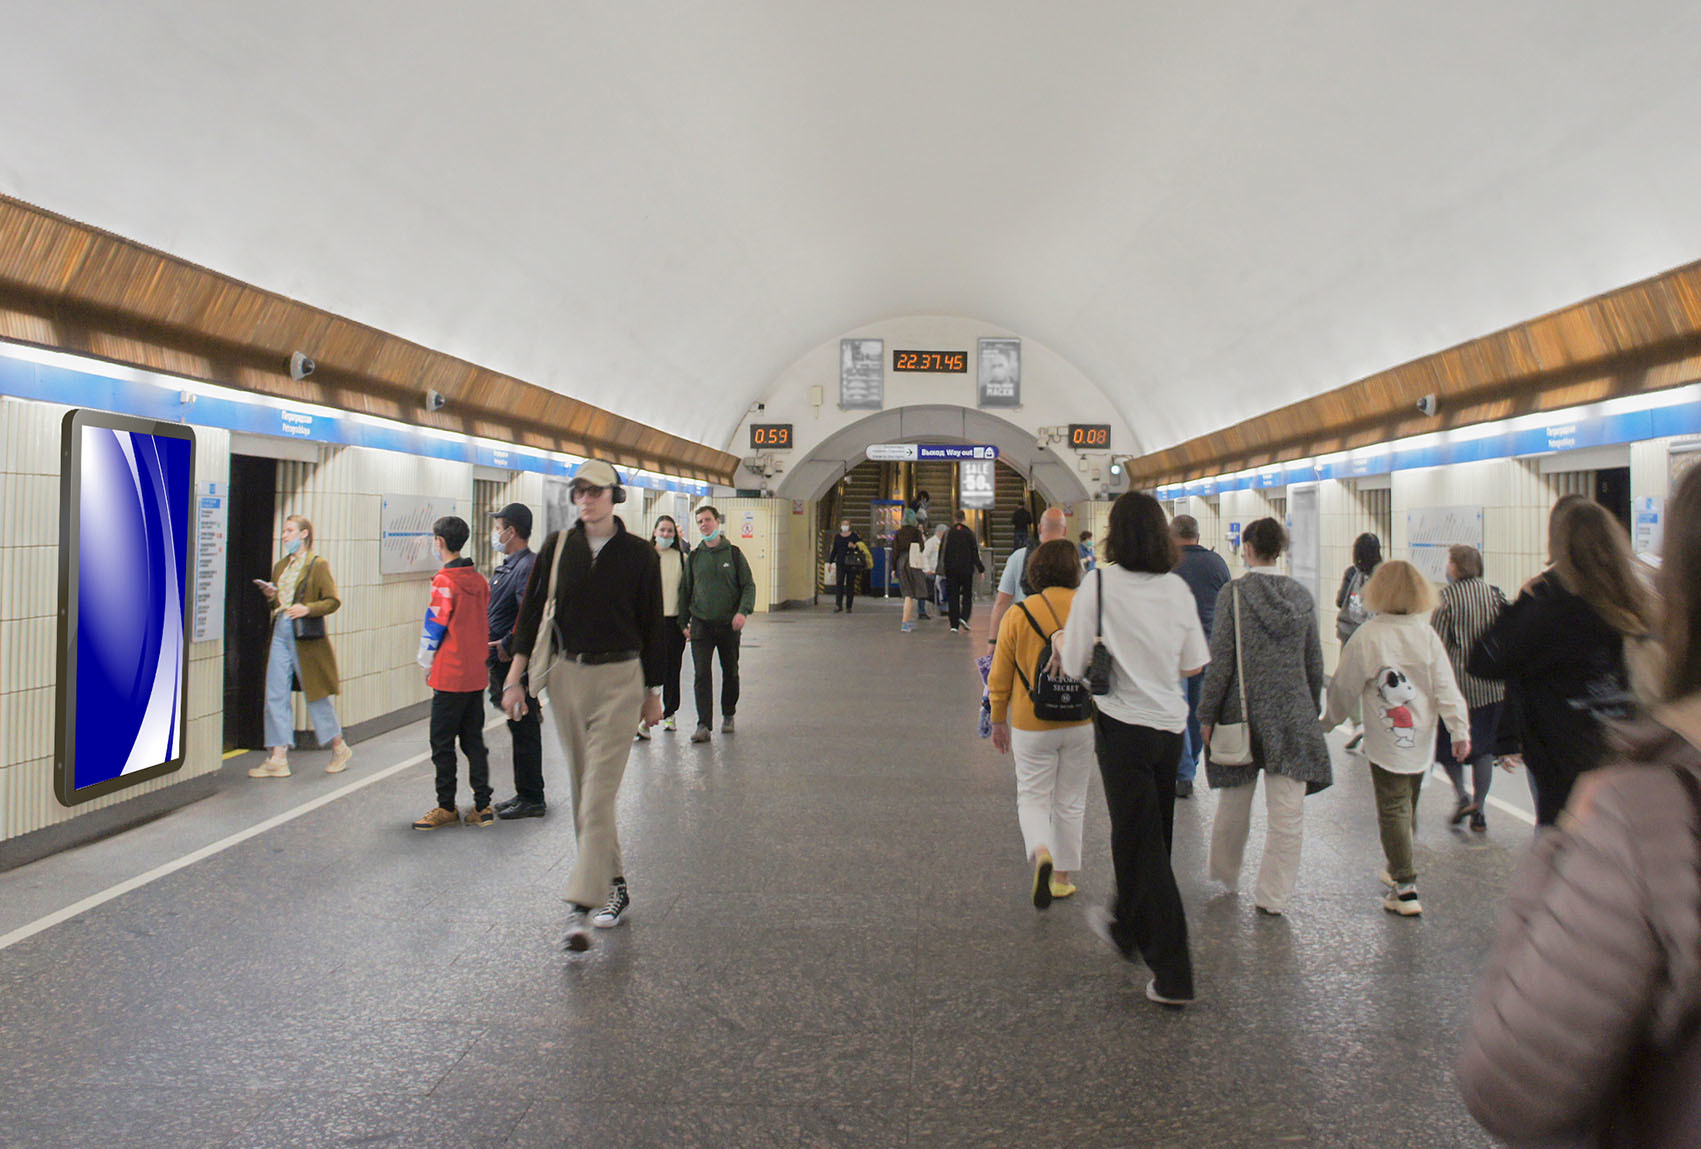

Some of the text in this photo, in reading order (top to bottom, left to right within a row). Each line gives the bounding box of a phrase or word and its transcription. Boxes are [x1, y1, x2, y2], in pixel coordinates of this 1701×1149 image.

[897, 353, 963, 370] 22.37.45
[754, 429, 788, 444] 0.59
[921, 448, 973, 458] Выход Way out
